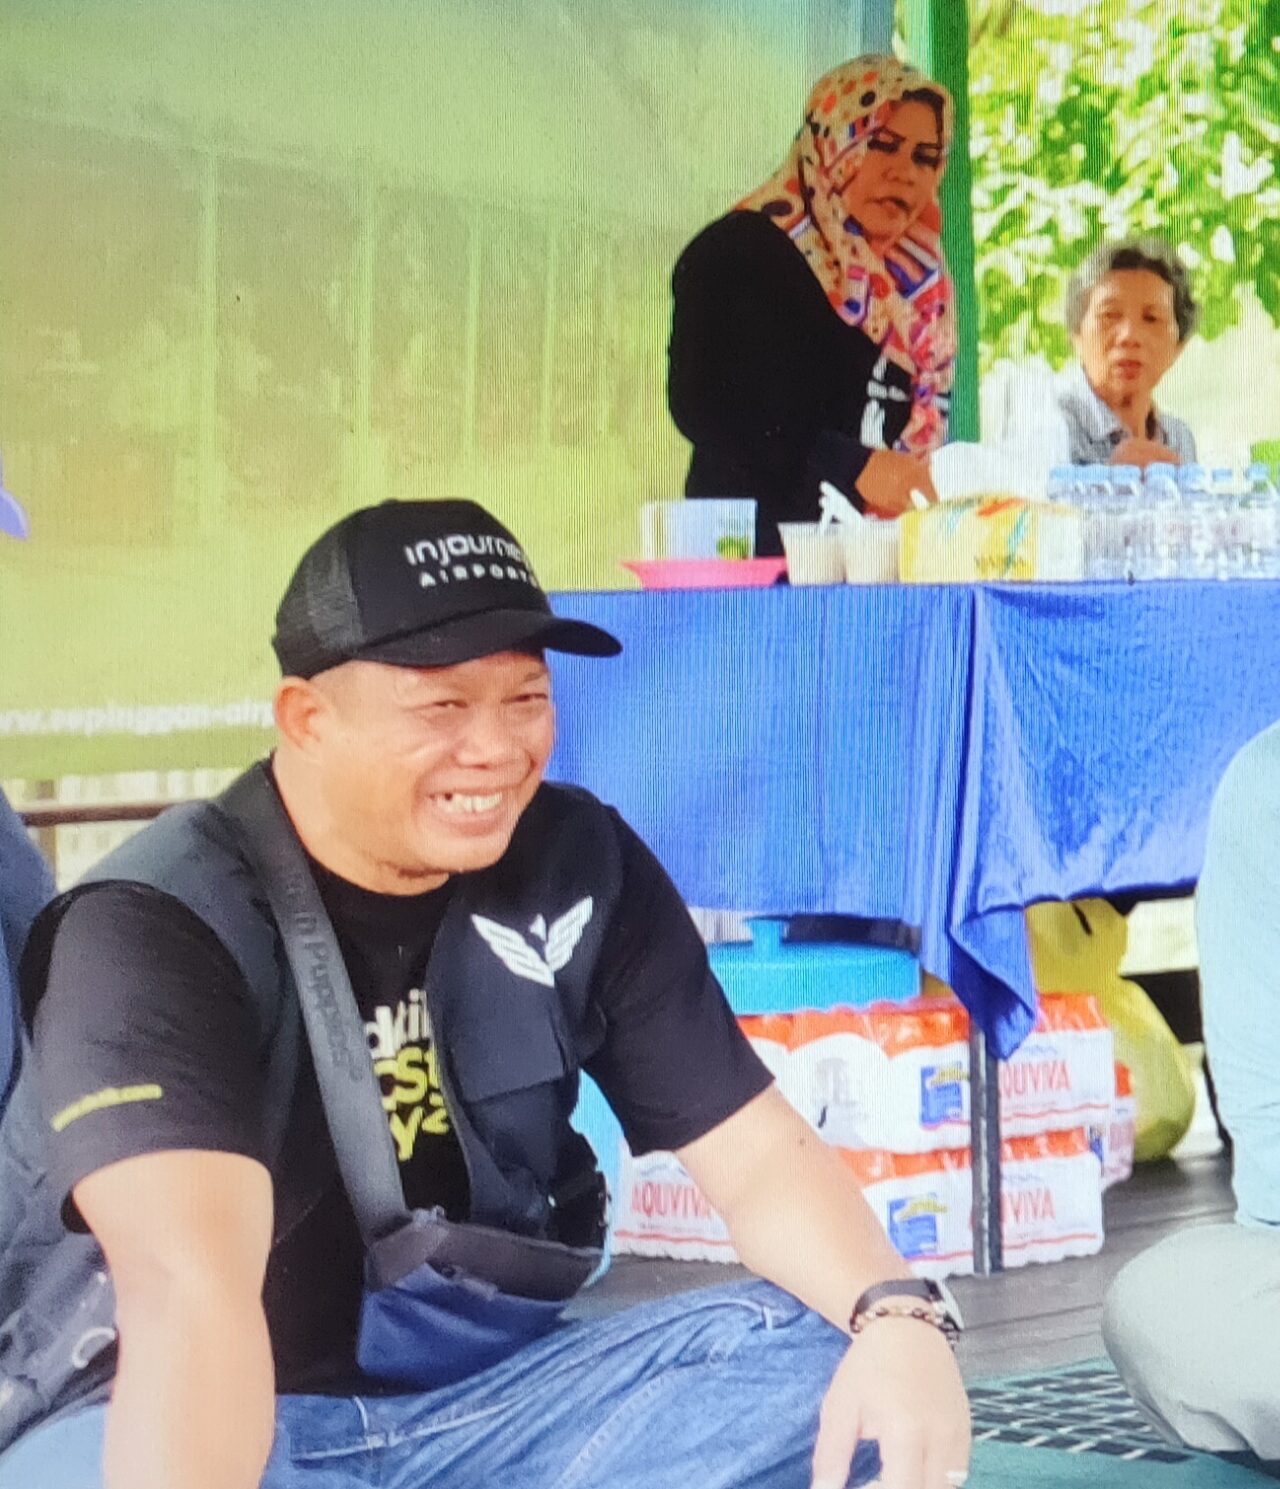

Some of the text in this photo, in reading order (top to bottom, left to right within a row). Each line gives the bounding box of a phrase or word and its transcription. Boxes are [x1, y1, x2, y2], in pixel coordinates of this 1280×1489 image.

[404, 534, 532, 567] injourne
[1001, 1060, 1071, 1099] QUVIVA
[1001, 1187, 1055, 1226] VIVA
